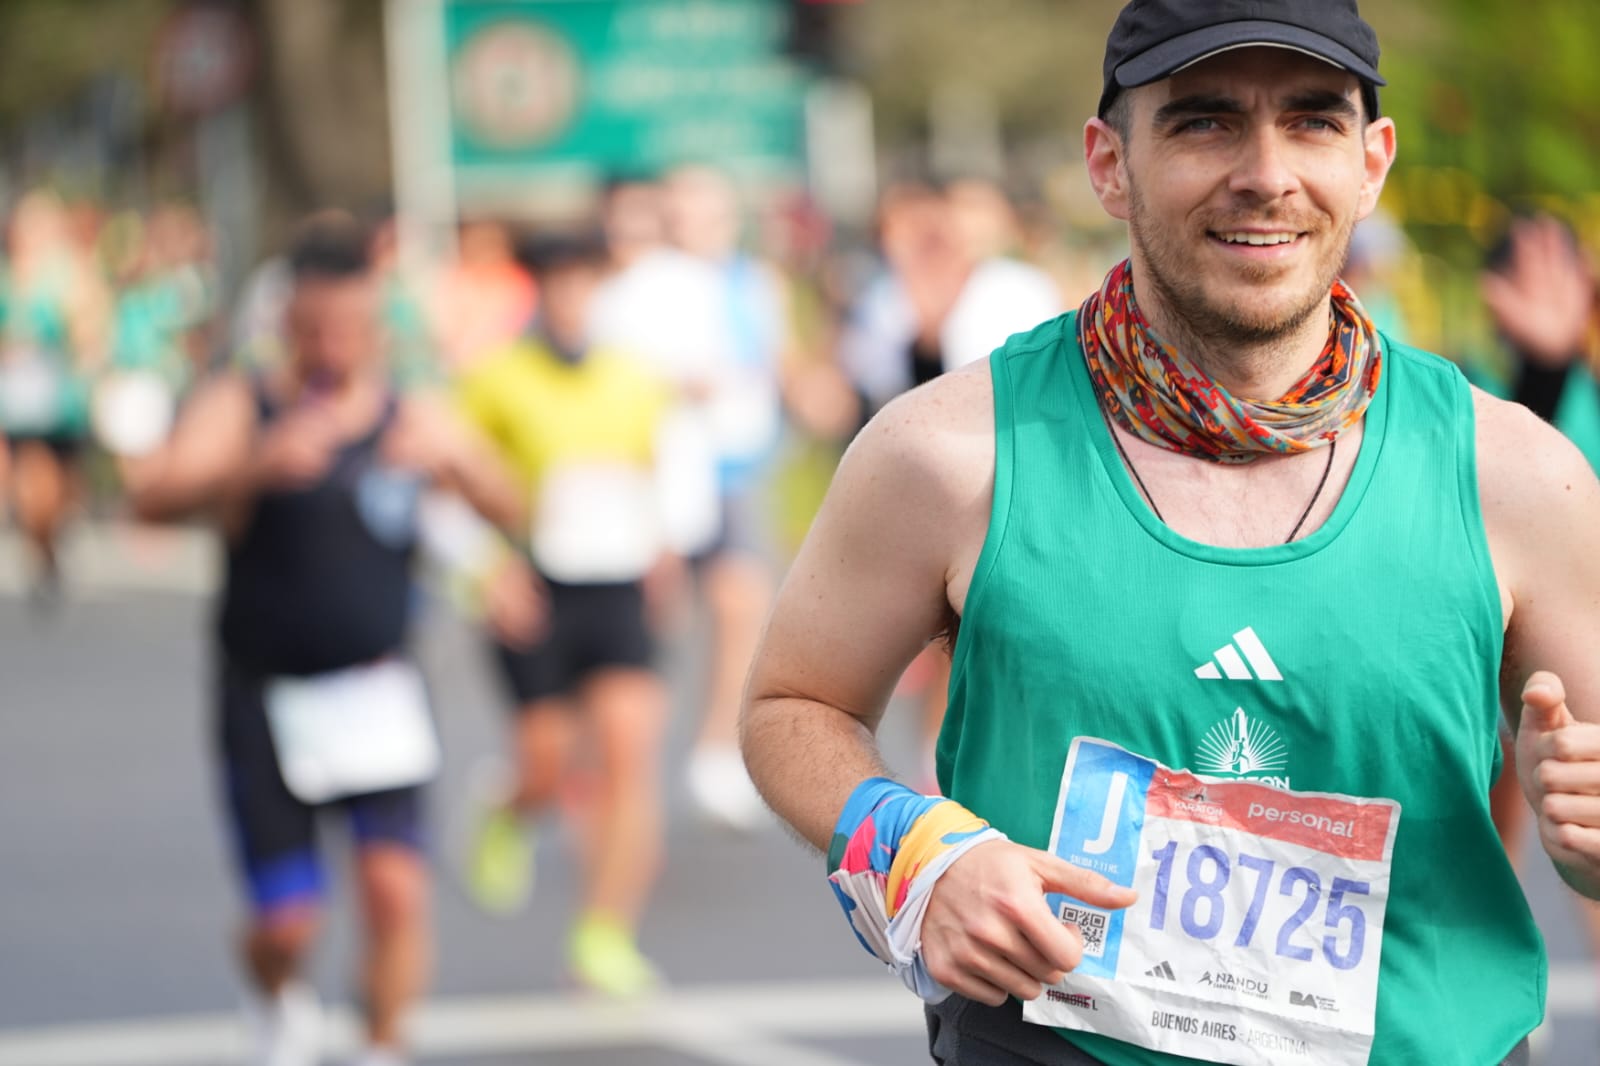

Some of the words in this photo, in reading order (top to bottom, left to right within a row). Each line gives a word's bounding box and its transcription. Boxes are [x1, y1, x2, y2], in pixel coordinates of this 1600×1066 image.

[1082, 771, 1129, 854] J
[1247, 801, 1354, 838] personal
[1150, 840, 1370, 970] 18725
[1152, 1010, 1199, 1034] BUENOS
[1201, 1020, 1237, 1041] AIRES
[1248, 1028, 1308, 1056] ARGENTINA
